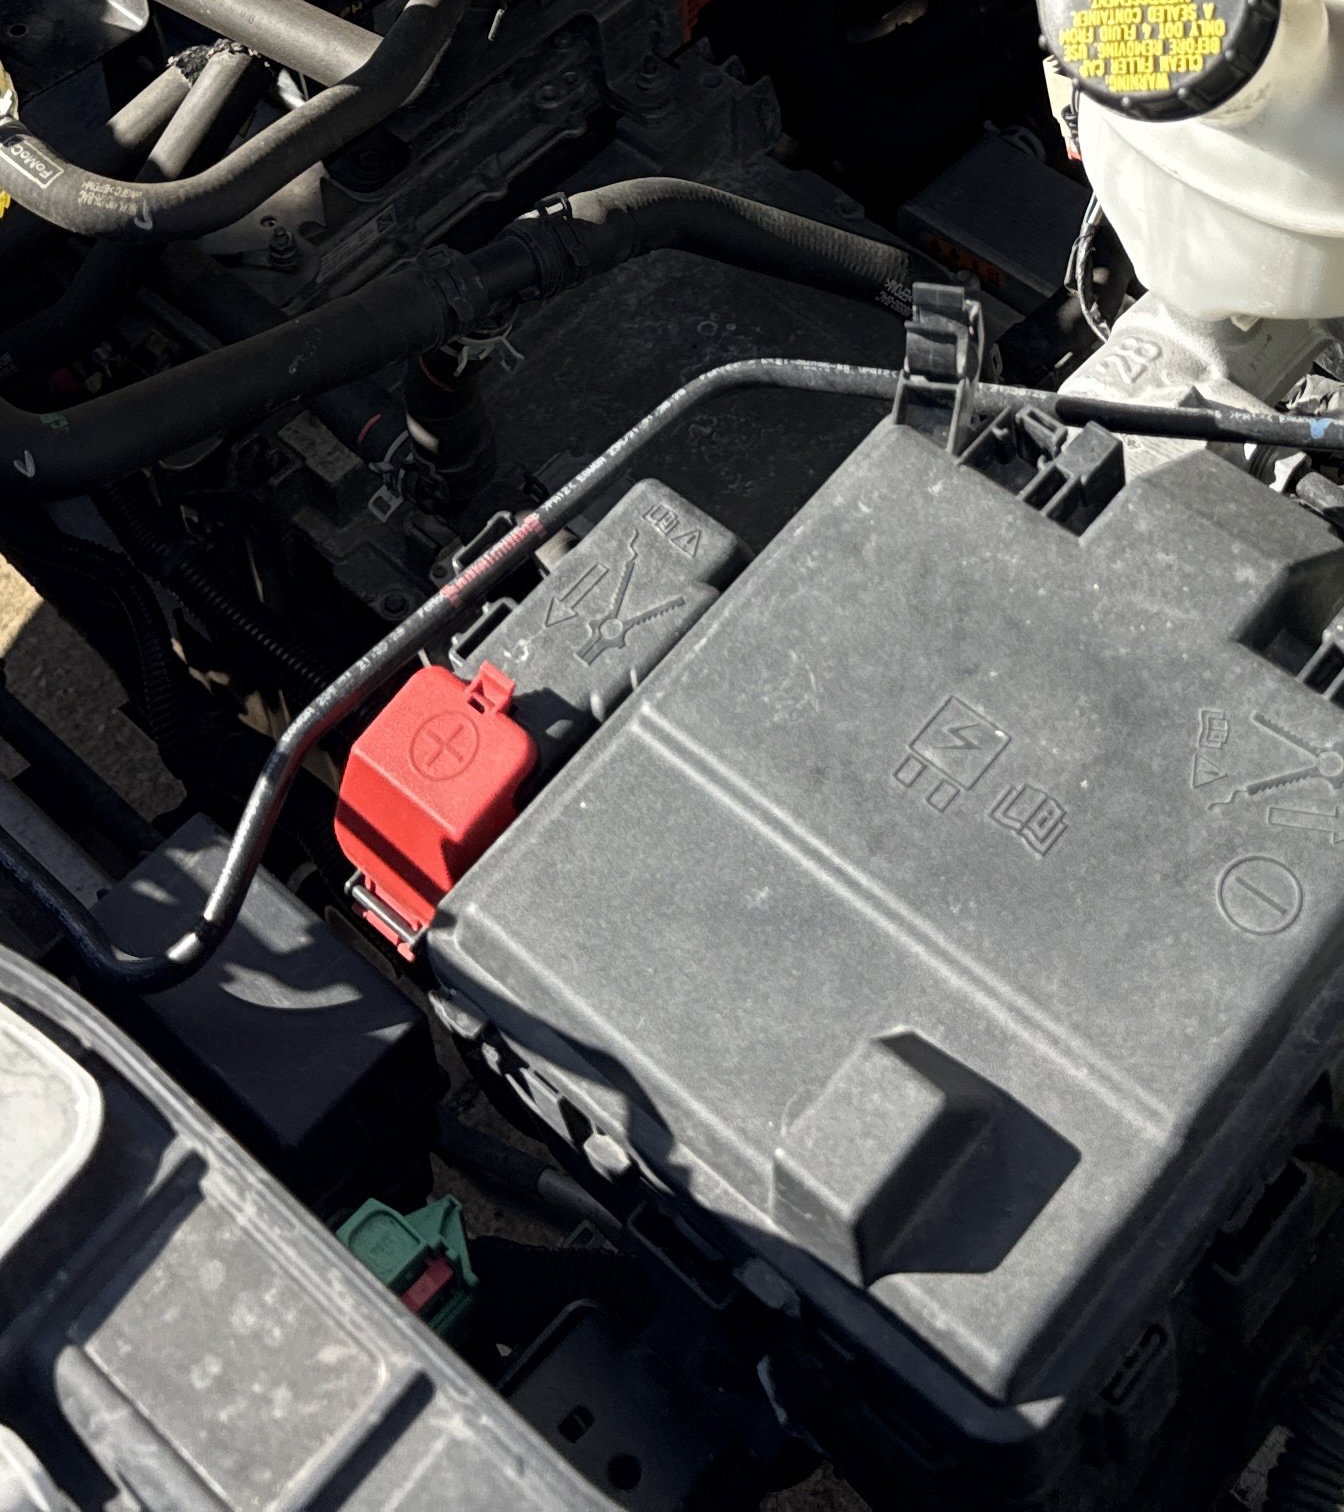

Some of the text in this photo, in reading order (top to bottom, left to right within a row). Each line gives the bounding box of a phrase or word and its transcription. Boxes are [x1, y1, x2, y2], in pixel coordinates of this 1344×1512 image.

[1147, 3, 1196, 20] SEALED
[1202, 2, 1213, 19] A
[1059, 26, 1093, 41] FROM
[1099, 23, 1135, 39] FLUID
[1158, 20, 1183, 37] DOT
[1190, 18, 1224, 36] ONLY
[1063, 44, 1087, 60] USE
[1168, 36, 1220, 55] BEFORE
[1078, 55, 1202, 76] CLEAN FILLER CAP
[5, 139, 55, 180] FoMoC
[1096, 337, 1161, 383] 28
